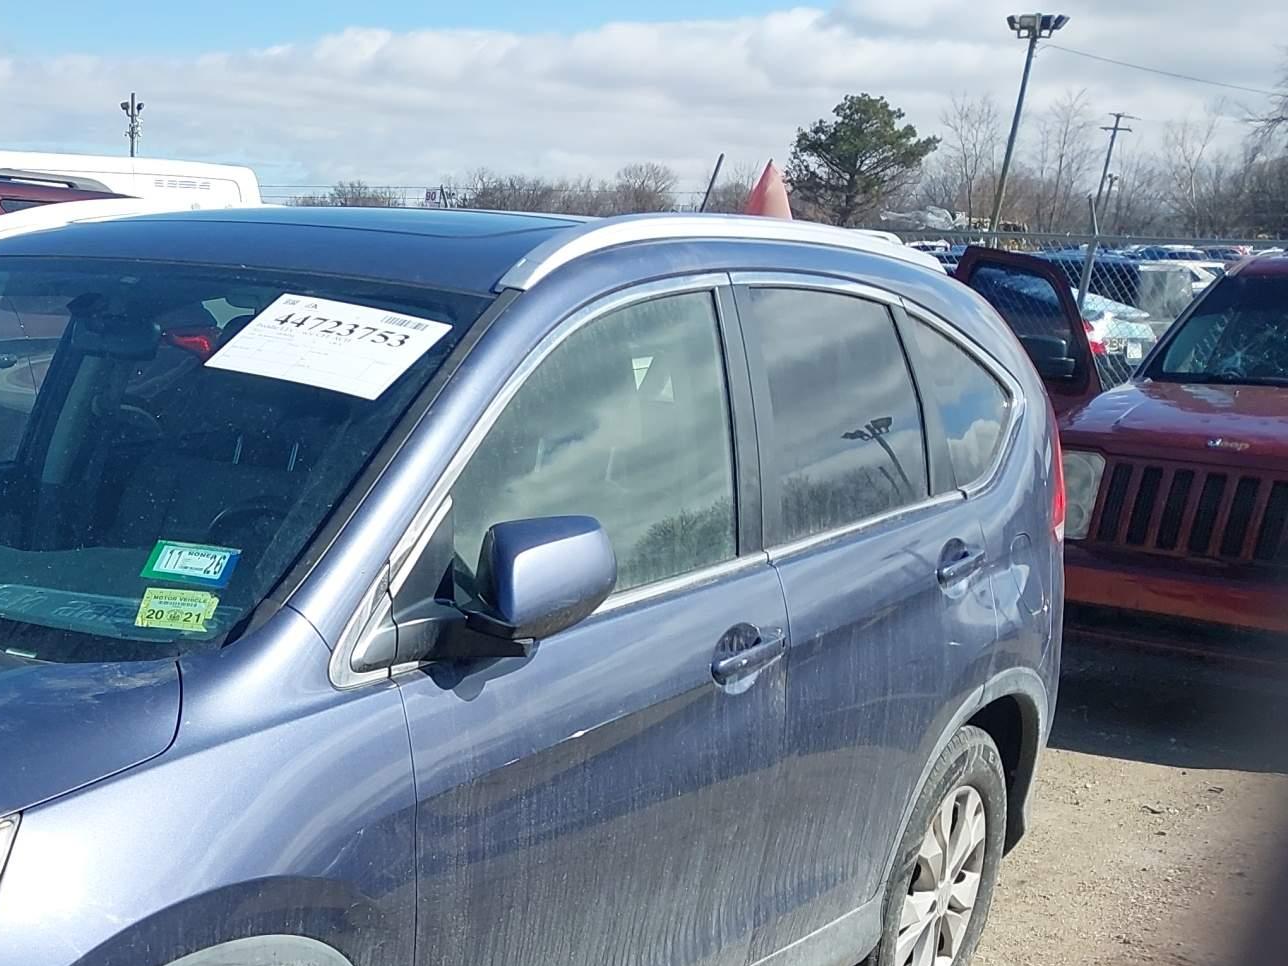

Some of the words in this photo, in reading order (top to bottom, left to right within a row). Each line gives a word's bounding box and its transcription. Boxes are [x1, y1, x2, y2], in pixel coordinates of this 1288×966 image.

[274, 312, 411, 347] 44723753
[146, 609, 164, 620] 20
[183, 612, 201, 623] 21
